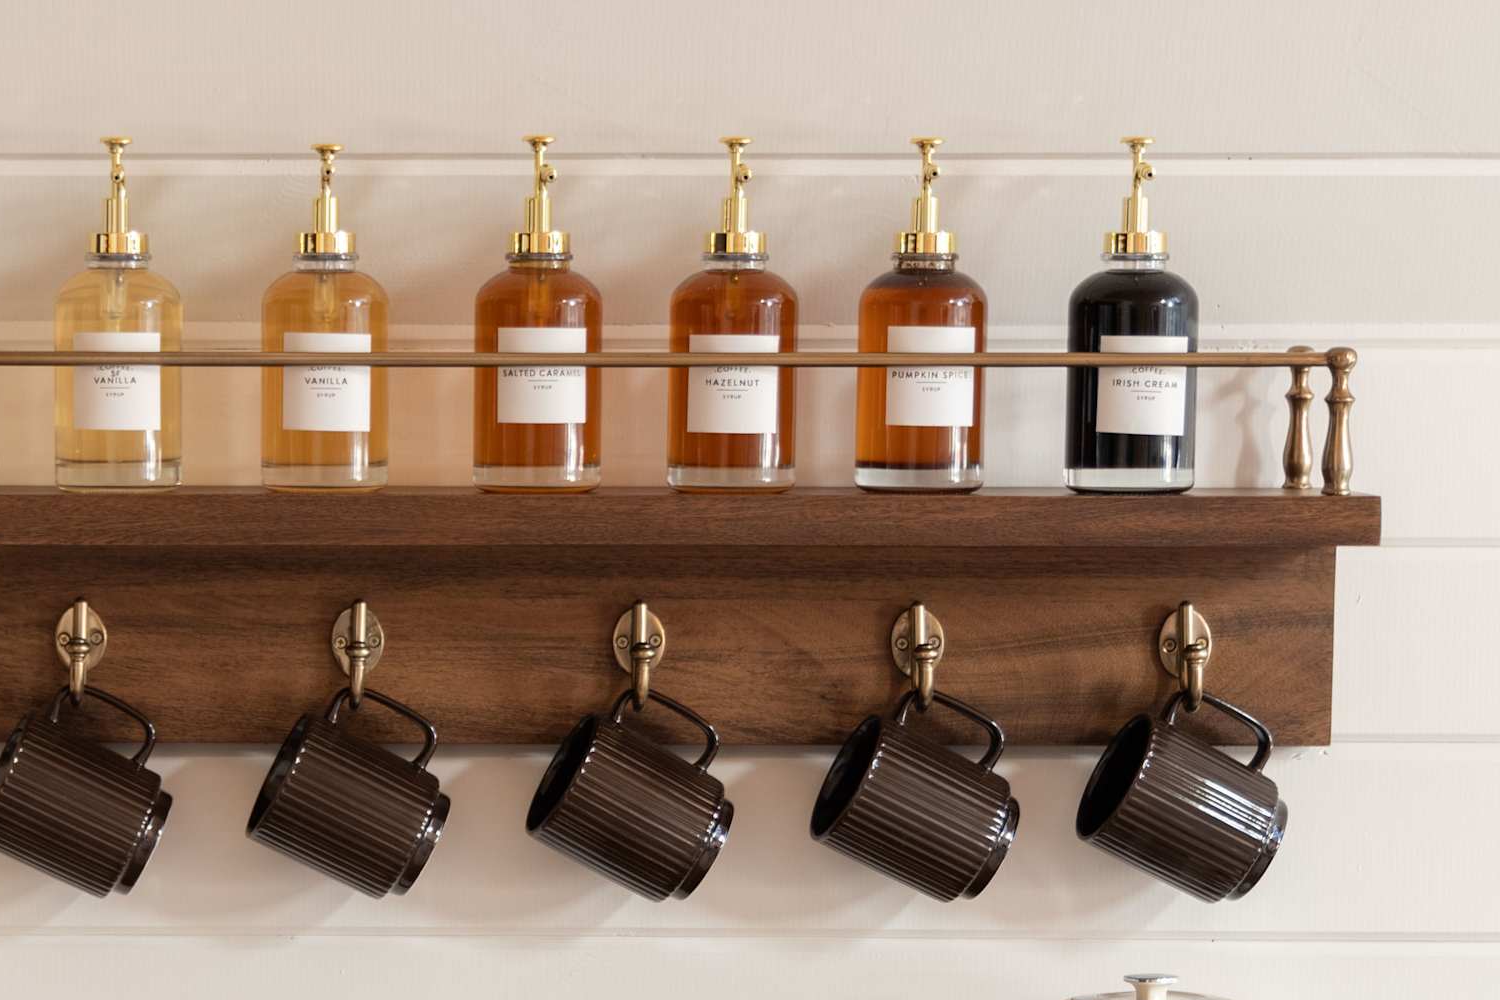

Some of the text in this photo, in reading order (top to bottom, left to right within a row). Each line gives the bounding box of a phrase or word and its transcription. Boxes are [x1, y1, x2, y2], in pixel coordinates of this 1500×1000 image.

[502, 369, 581, 377] SALTED CARAMEL
[891, 371, 968, 379] PUMPKIN SPICE
[93, 377, 137, 385] VANILLA
[304, 377, 348, 385] VANILLA
[705, 379, 760, 387] HAZELNUT
[1112, 379, 1178, 388] IRISH CREAM
